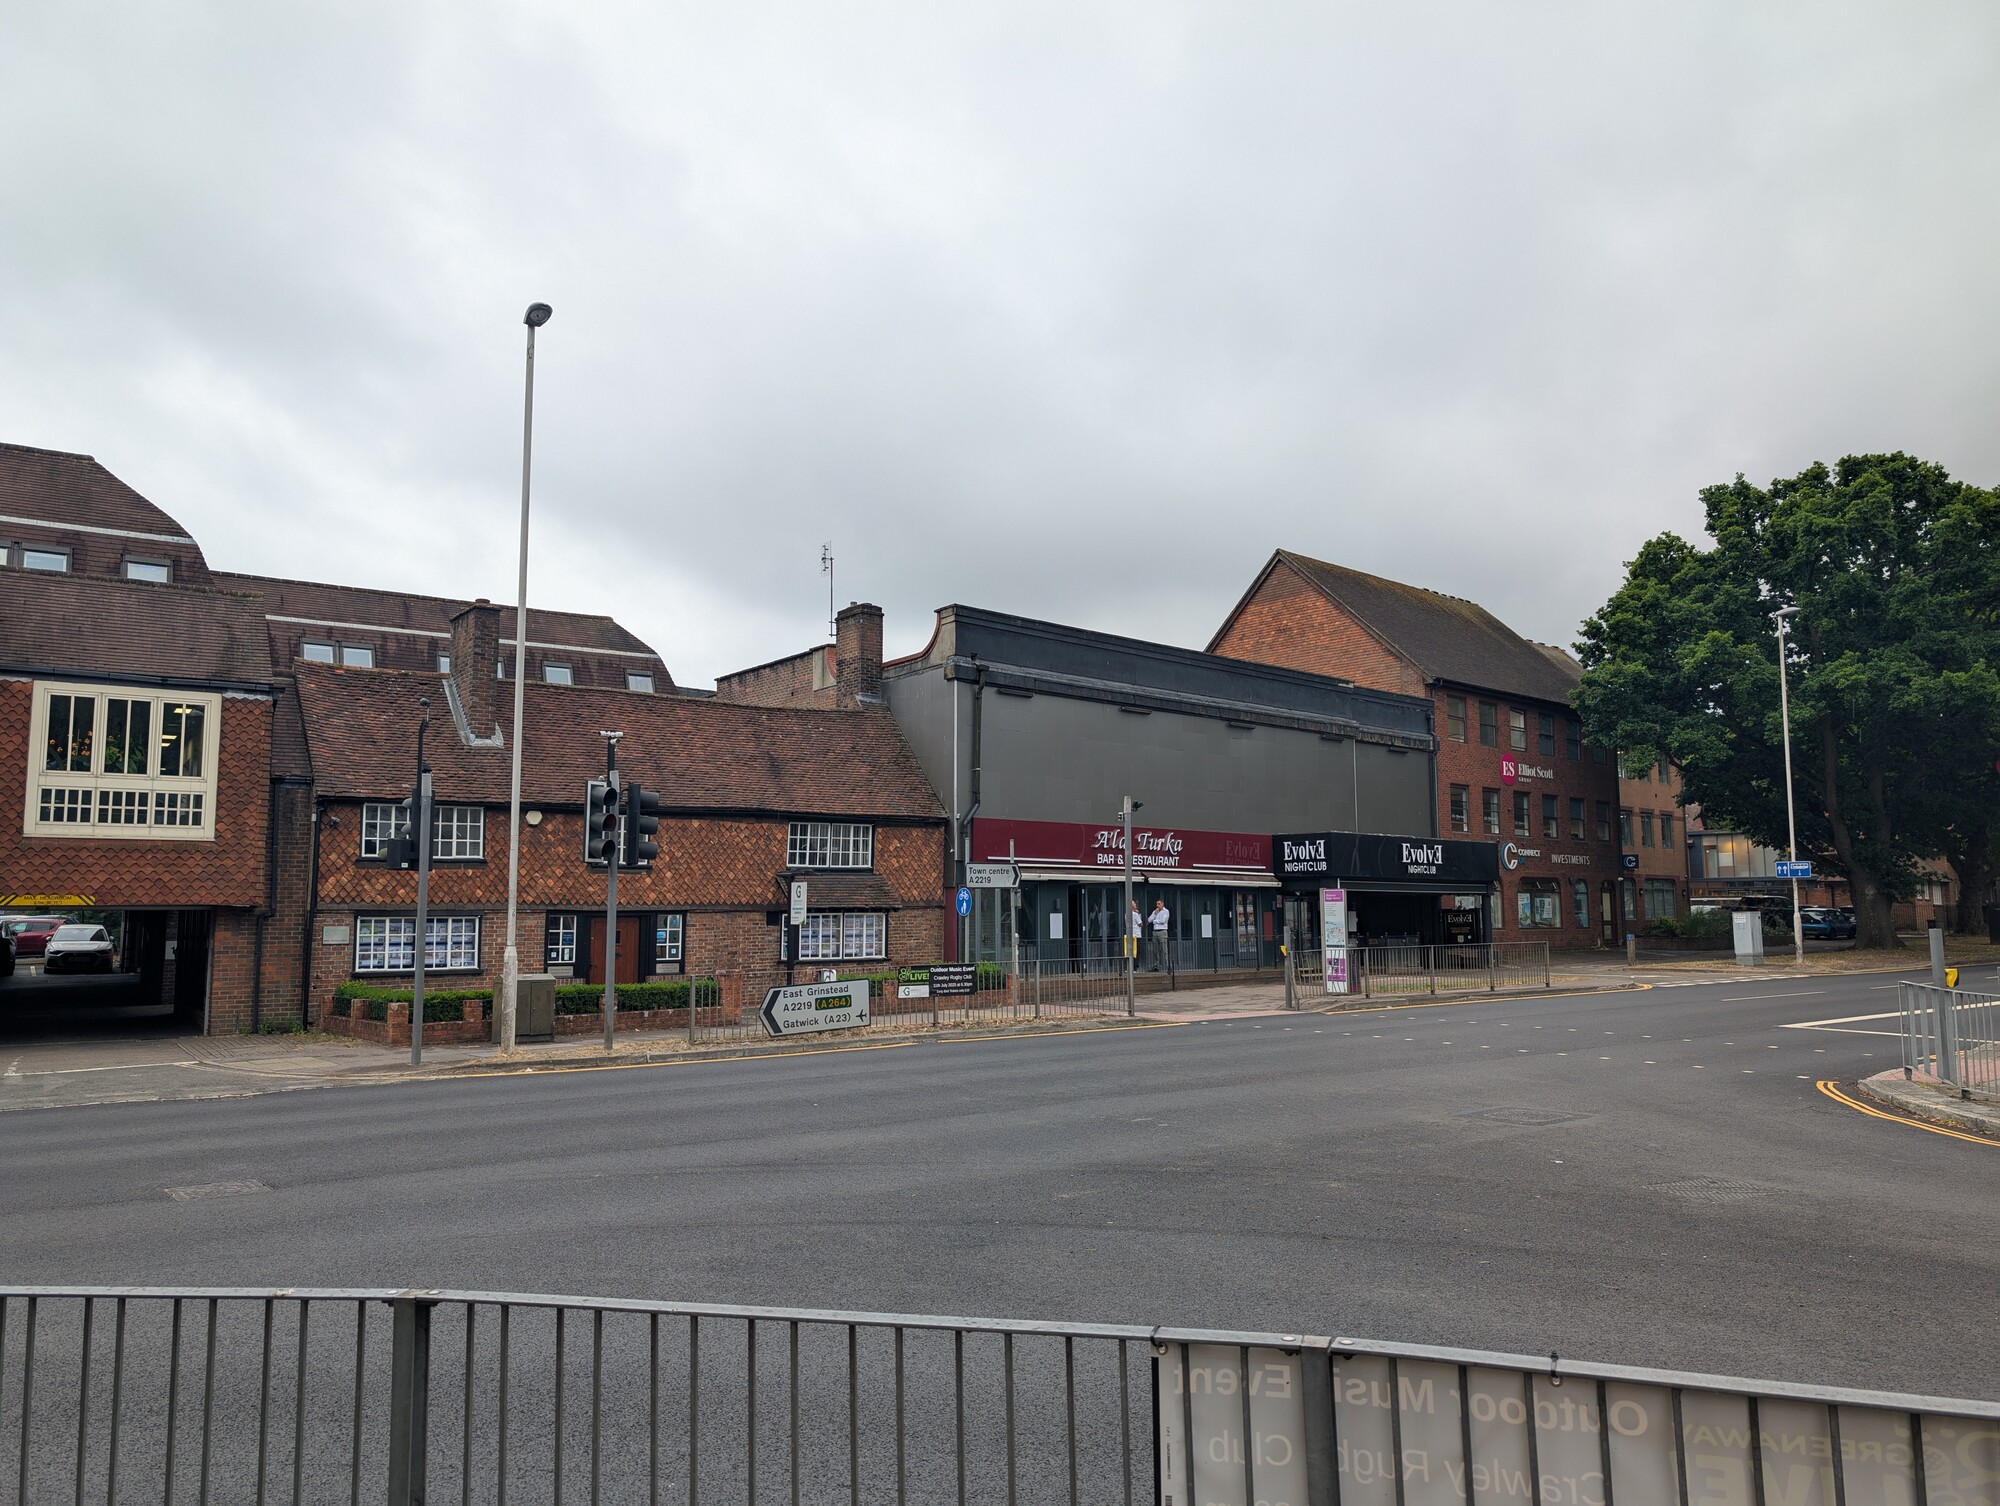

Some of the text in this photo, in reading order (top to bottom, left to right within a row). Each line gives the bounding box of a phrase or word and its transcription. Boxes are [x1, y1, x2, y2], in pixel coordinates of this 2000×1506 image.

[1502, 761, 1515, 776] ES
[1518, 763, 1553, 779] Elliot Scott
[1137, 832, 1183, 855] Turka
[1097, 854, 1180, 867] BAR & ESTAURANT
[1552, 854, 1590, 865] INVESTMENTS
[1285, 862, 1327, 872] NIGHTCLUB
[1408, 865, 1436, 874] NIGHTCLUB
[783, 985, 849, 998] East Grinstead
[783, 997, 851, 1012] A2219 (A264)
[783, 1012, 851, 1028] Gatwick (A23)
